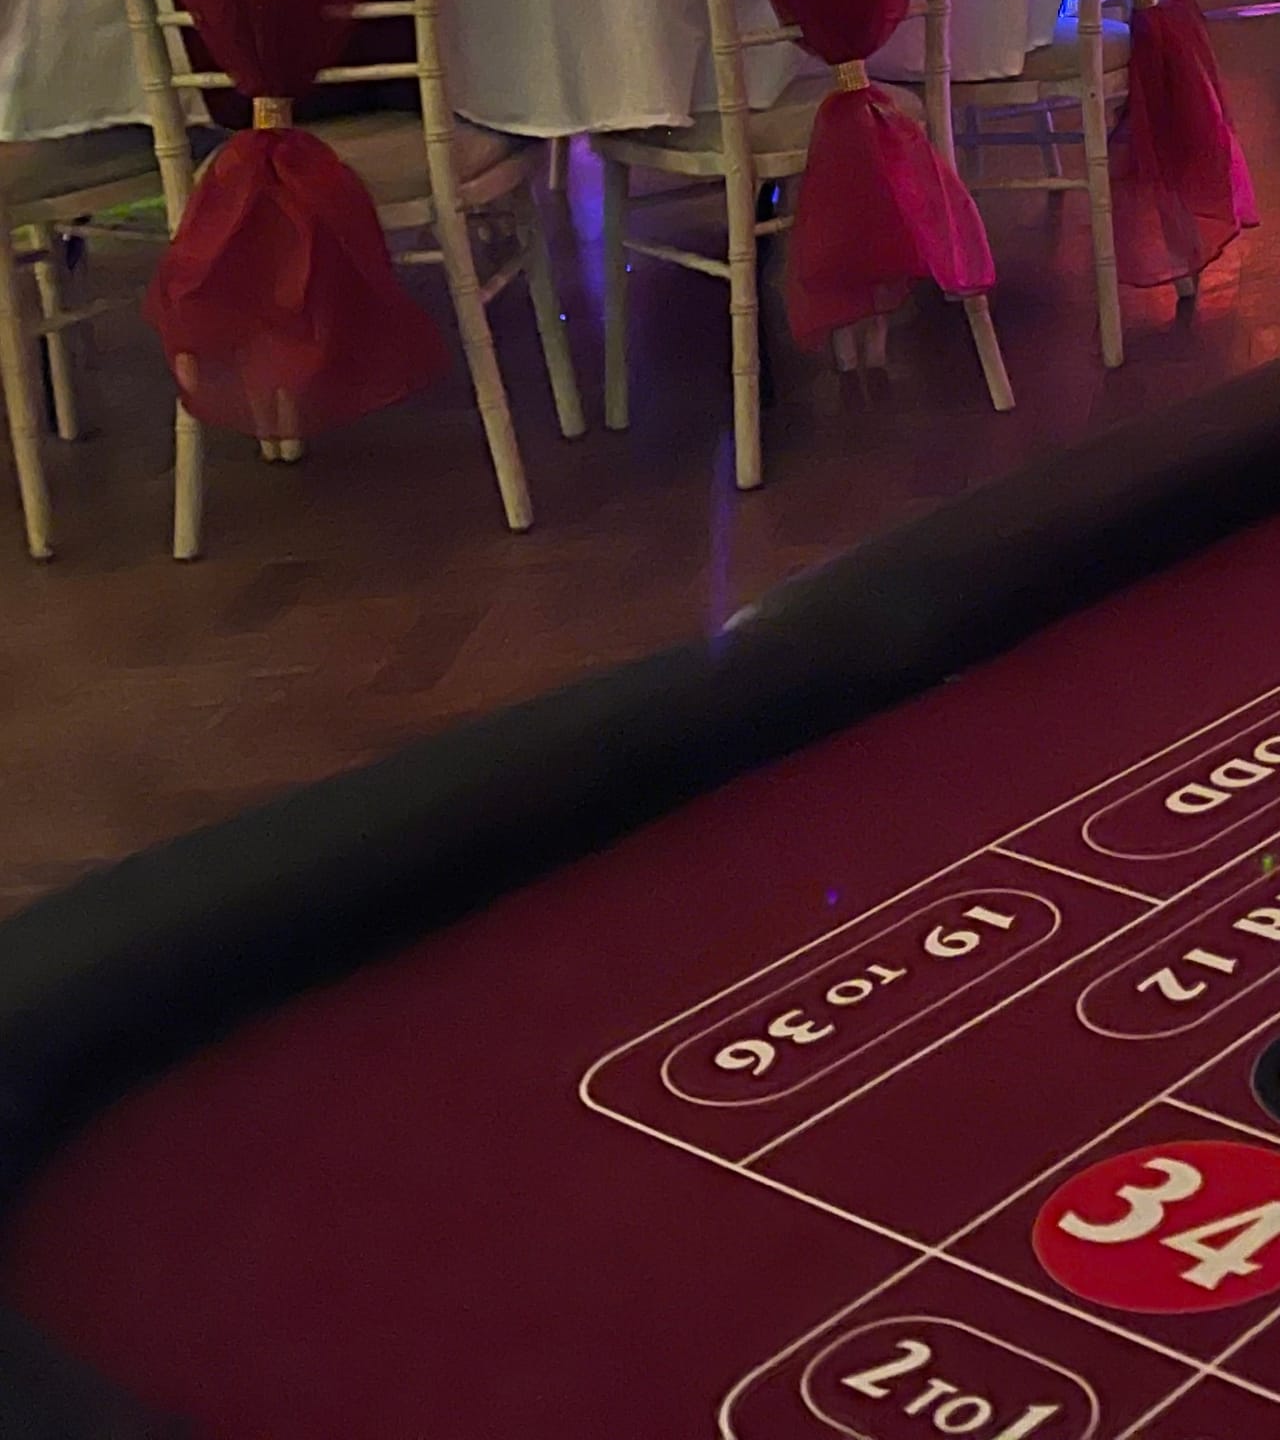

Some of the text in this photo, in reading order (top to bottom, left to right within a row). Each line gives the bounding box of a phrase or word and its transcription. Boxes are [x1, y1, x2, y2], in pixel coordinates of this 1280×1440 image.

[922, 904, 1017, 960] 19
[1136, 947, 1239, 1003] 12
[712, 1008, 836, 1077] 36
[839, 1337, 933, 1399] 2
[990, 1403, 1061, 1440] 1
